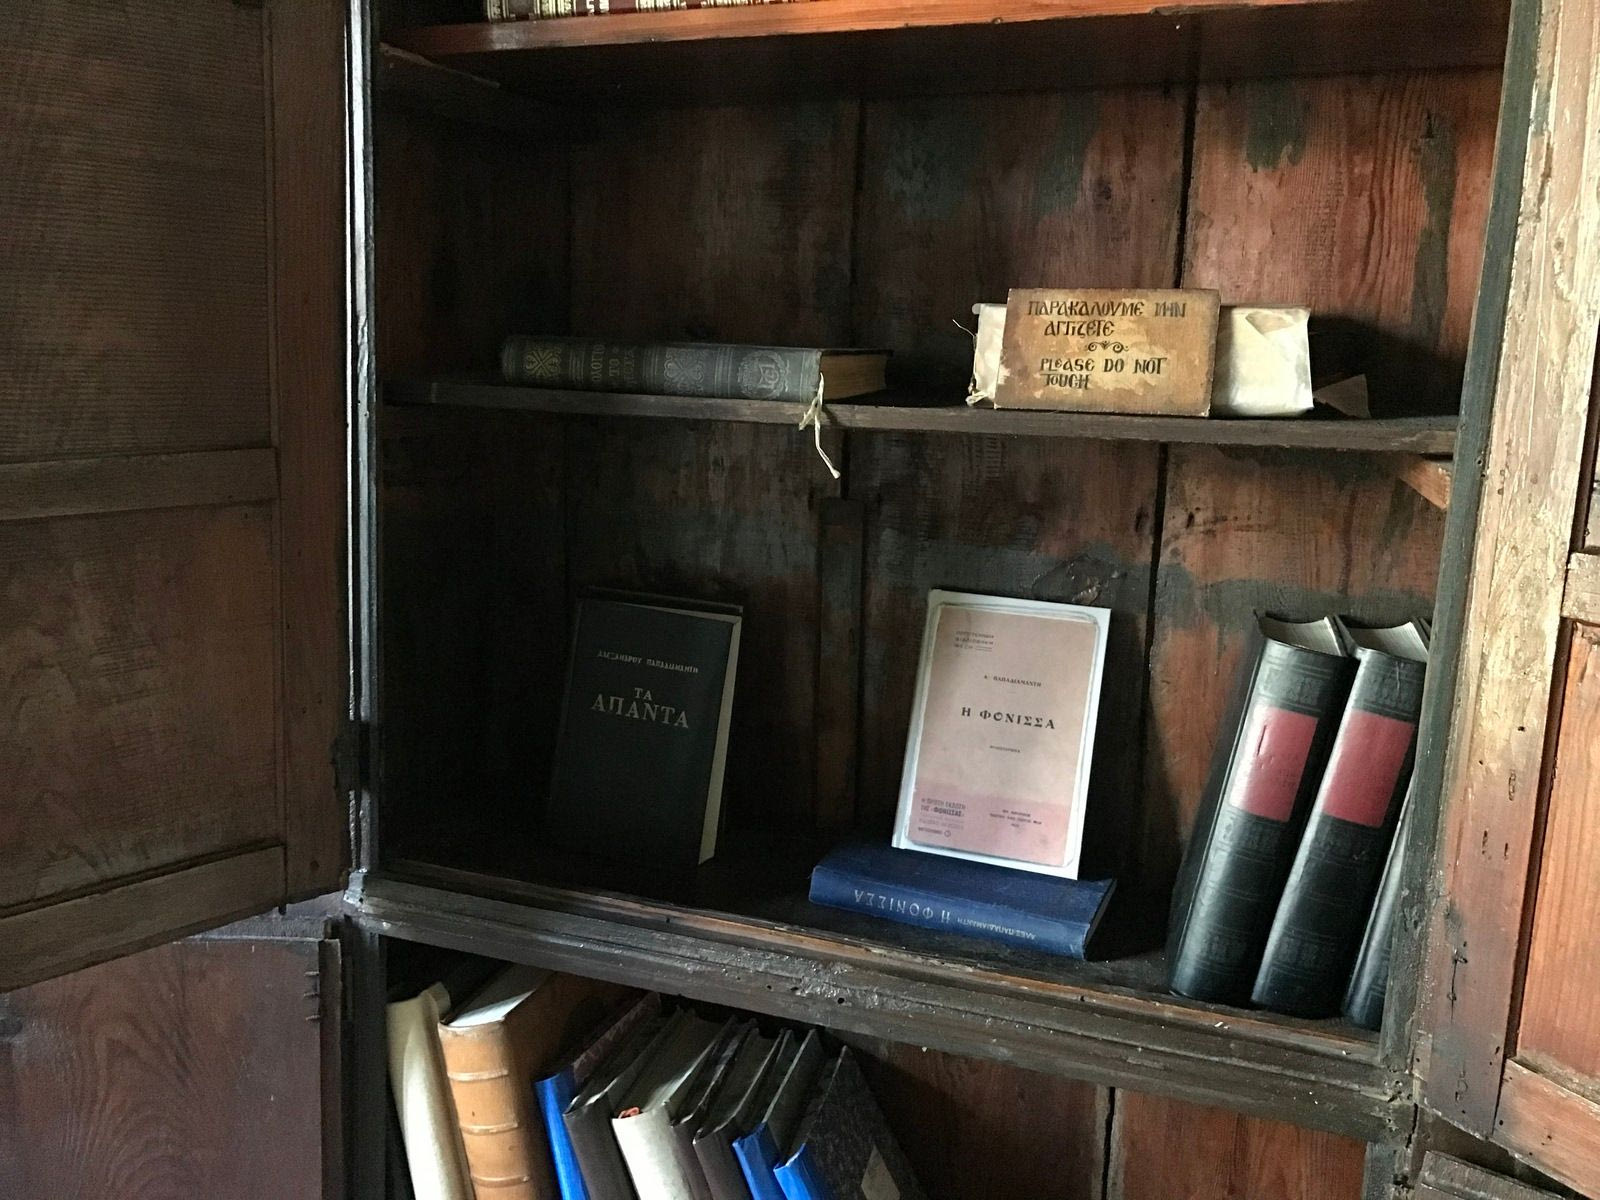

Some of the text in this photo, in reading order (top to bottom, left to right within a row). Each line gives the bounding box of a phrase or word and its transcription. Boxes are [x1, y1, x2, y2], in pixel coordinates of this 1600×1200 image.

[1028, 299, 1188, 318] ΠΑΡΑΚΑΛΟΥΜΕ ΜΗΝ
[1040, 357, 1168, 374] PLEASE DO NOT
[1041, 373, 1092, 390] TOUCH
[993, 676, 1042, 687] ΠΑΠΑΔΙΑΜΑΝΤΗ
[634, 687, 653, 701] ΤΑ
[591, 693, 689, 729] ΑΠΑΝΤΑ
[961, 707, 1056, 730] Η ΦΟΝΙΣΣΑ
[854, 889, 934, 919] ΦΟΝΙΣΣΑ
[940, 909, 951, 924] Η
